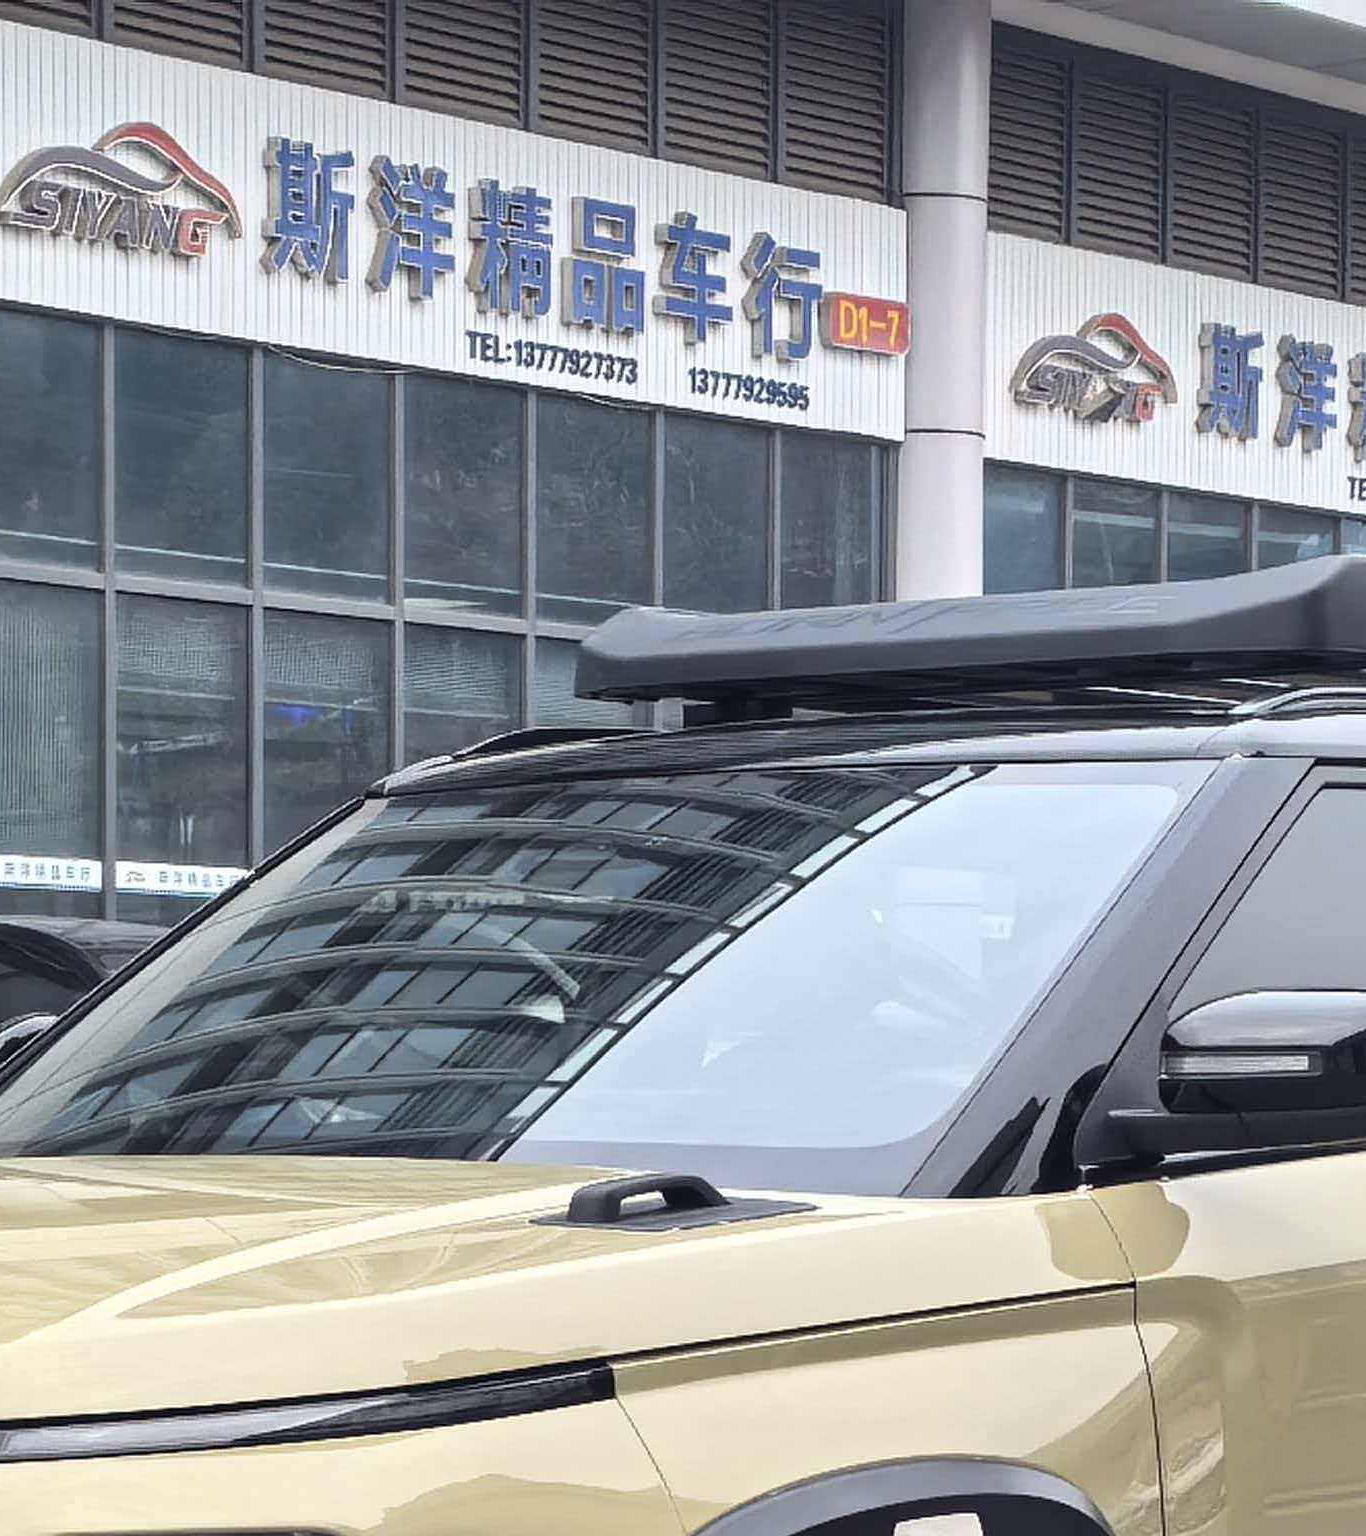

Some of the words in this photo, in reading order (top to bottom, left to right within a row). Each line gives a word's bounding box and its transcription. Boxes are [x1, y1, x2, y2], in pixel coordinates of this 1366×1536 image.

[262, 135, 823, 363] 斯洋精品车行
